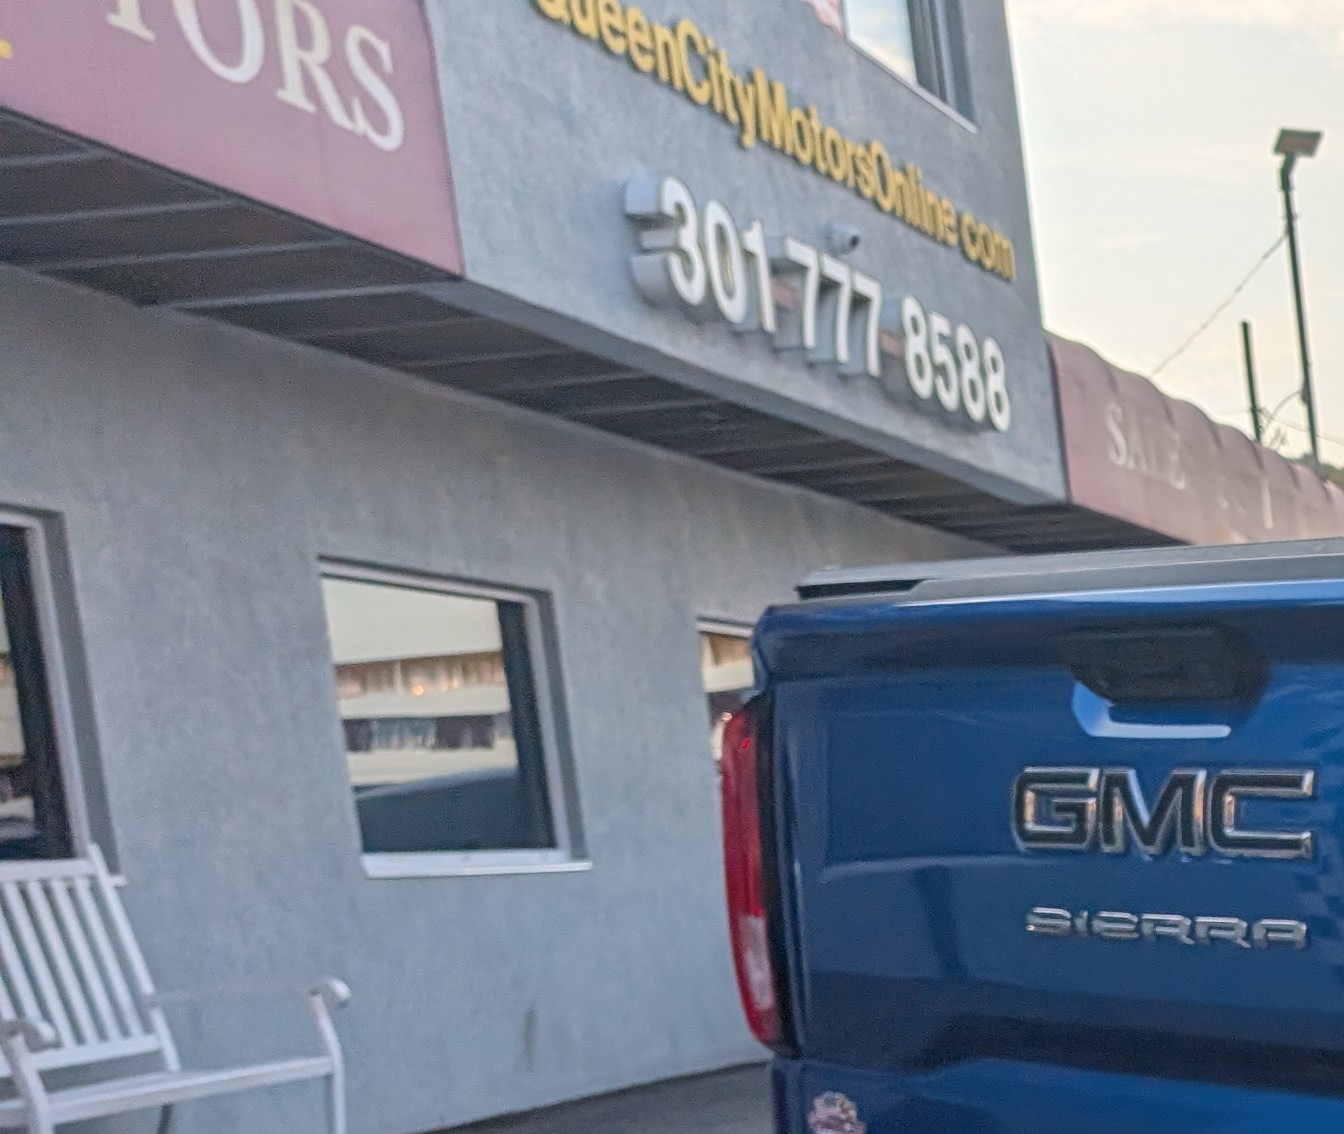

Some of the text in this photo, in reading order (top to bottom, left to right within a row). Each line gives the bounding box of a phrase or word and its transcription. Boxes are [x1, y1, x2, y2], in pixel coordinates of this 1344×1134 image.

[105, 0, 405, 152] ORS
[650, 177, 1010, 431] 301 777 8588
[1012, 765, 1316, 860] GMC
[1025, 906, 1308, 949] SIERRA
